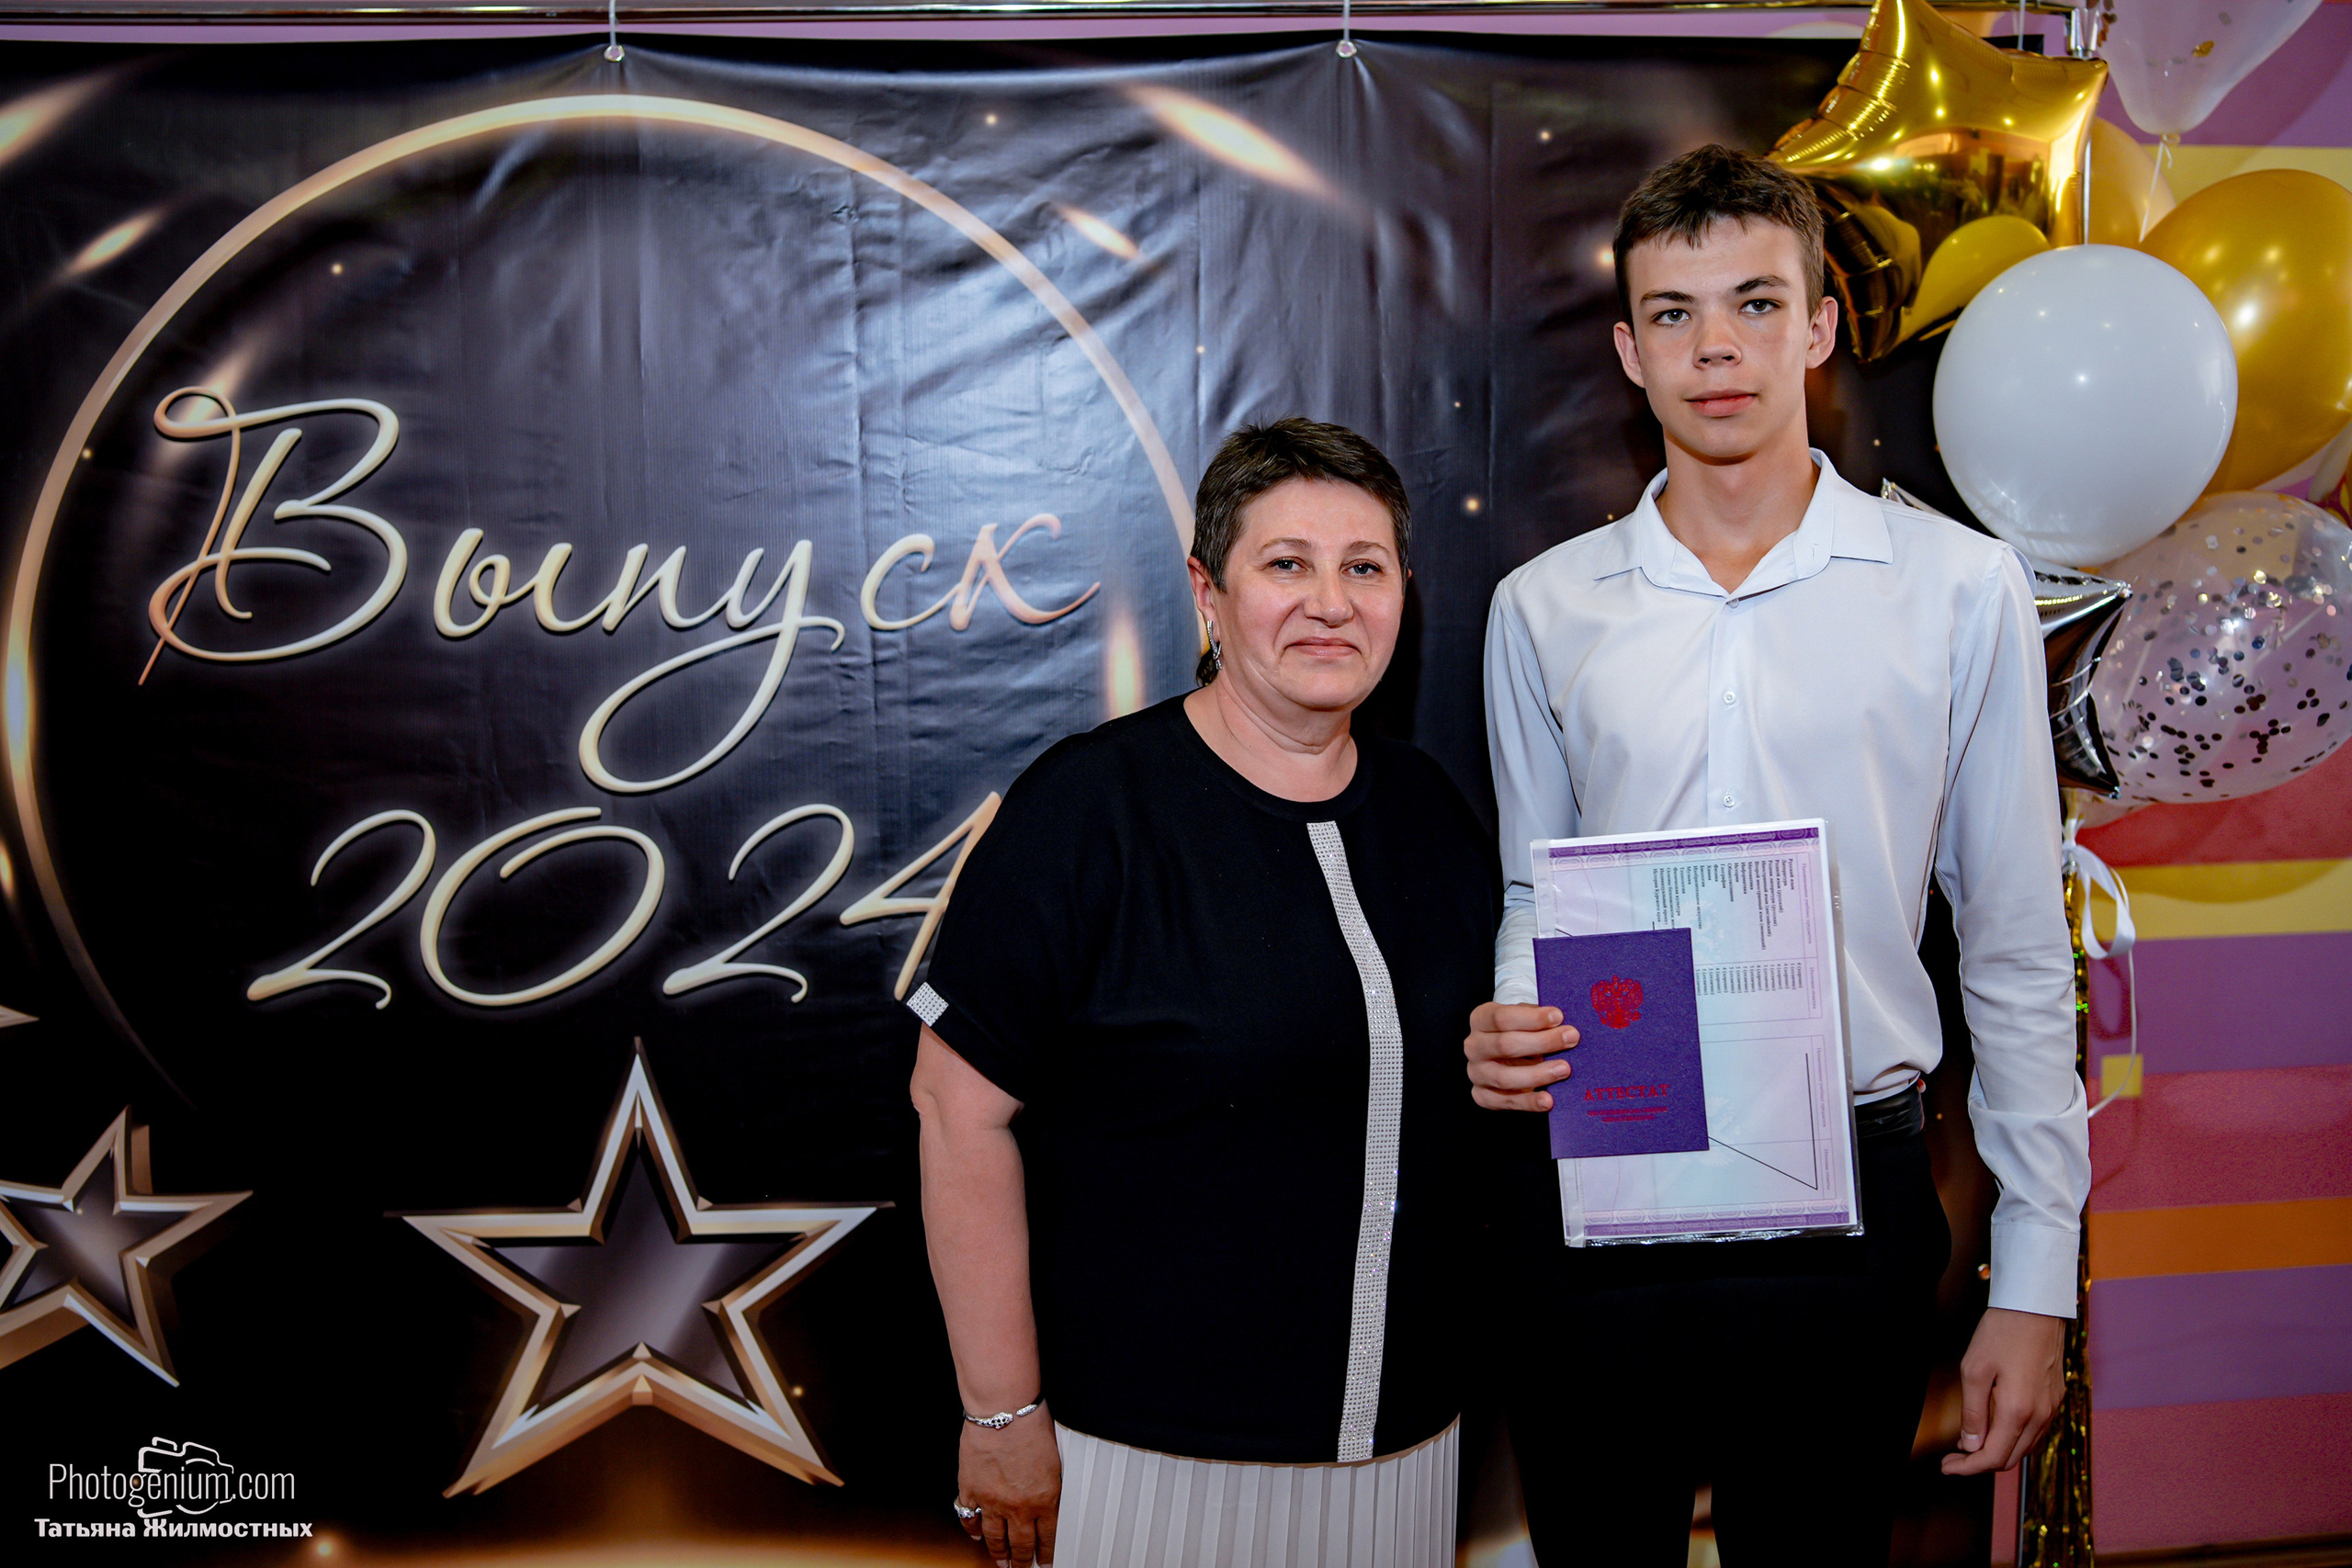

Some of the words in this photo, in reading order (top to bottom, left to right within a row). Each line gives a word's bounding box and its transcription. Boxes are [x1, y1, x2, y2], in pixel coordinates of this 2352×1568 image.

[137, 386, 1101, 795] Выпуск
[247, 792, 1001, 1009] 2024
[1584, 1084, 1670, 1101] АТТЕСТАТ
